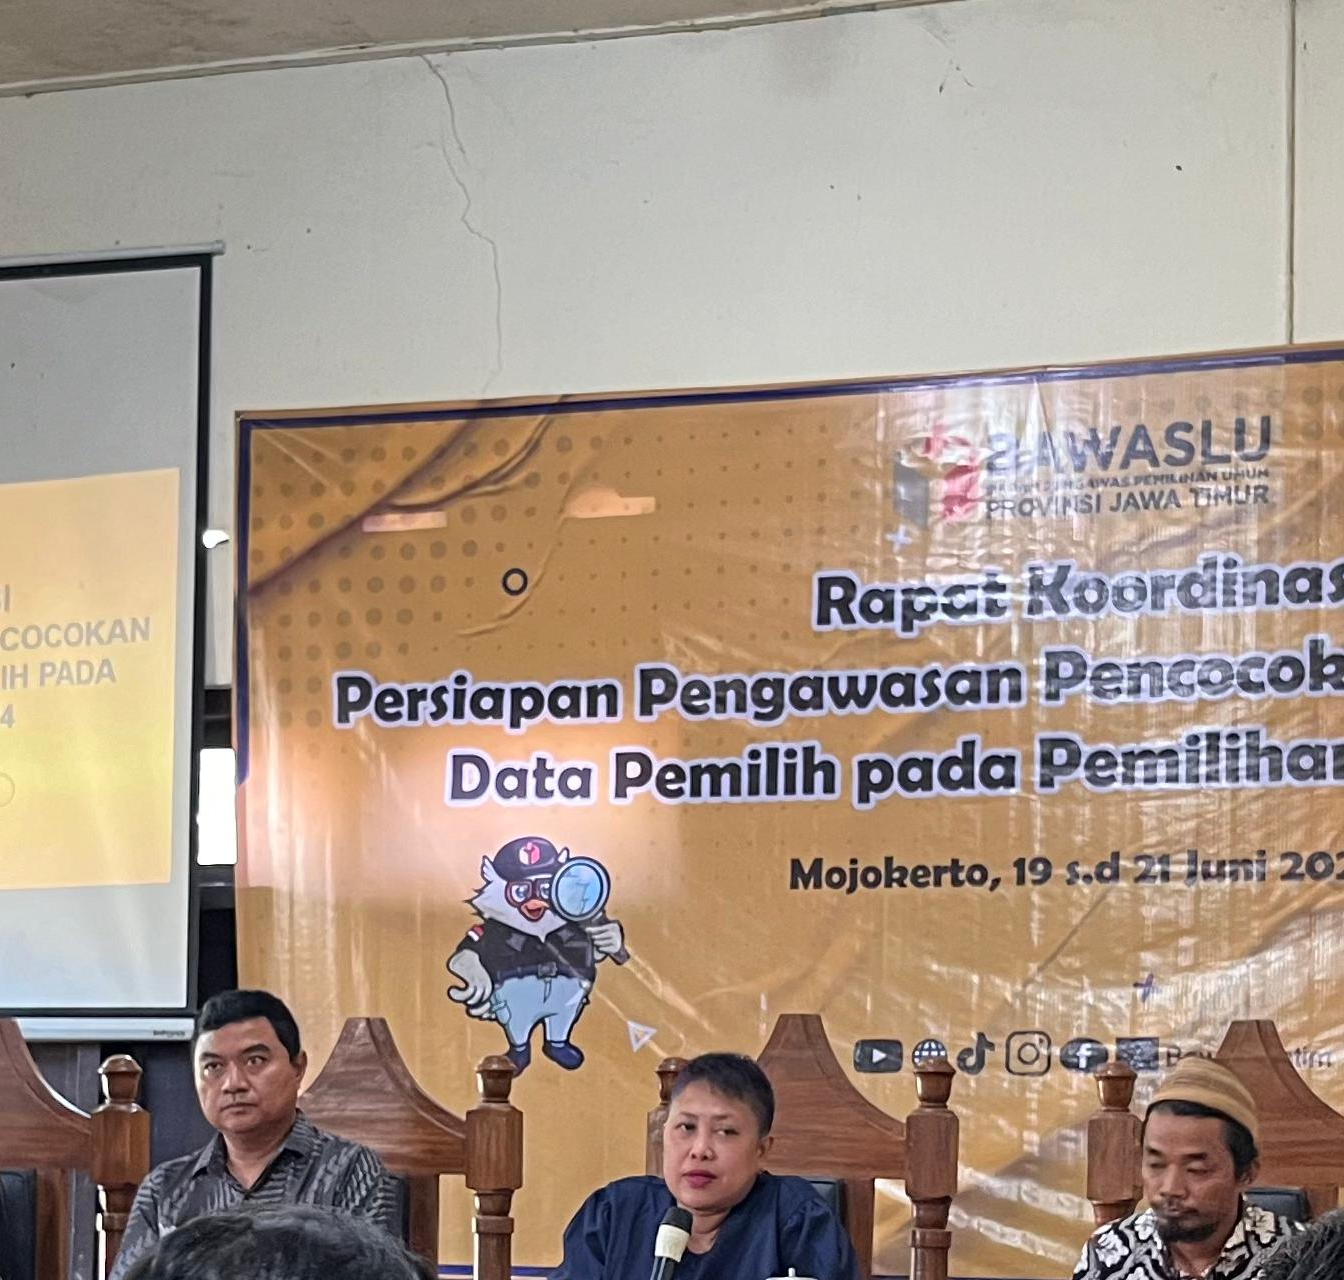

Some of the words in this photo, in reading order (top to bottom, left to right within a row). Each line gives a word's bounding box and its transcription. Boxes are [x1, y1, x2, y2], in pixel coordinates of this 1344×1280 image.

[987, 415, 1271, 472] BAWASLU
[987, 495, 1100, 519] PROVINSI
[1110, 488, 1181, 513] JAWA
[1190, 484, 1269, 508] TIMUR
[817, 572, 1006, 633] Rapat
[39, 658, 116, 687] PADA
[337, 675, 618, 729] Persiapan
[639, 666, 1021, 722] Pengawasan
[452, 752, 593, 799] Data
[615, 746, 836, 799] Pemilih
[858, 740, 1017, 804] pada
[789, 856, 1002, 894] Mojokerto,
[1013, 856, 1052, 885] 19
[1065, 851, 1120, 886] s.d
[1133, 854, 1170, 884] 21
[1184, 850, 1267, 886] Juni
